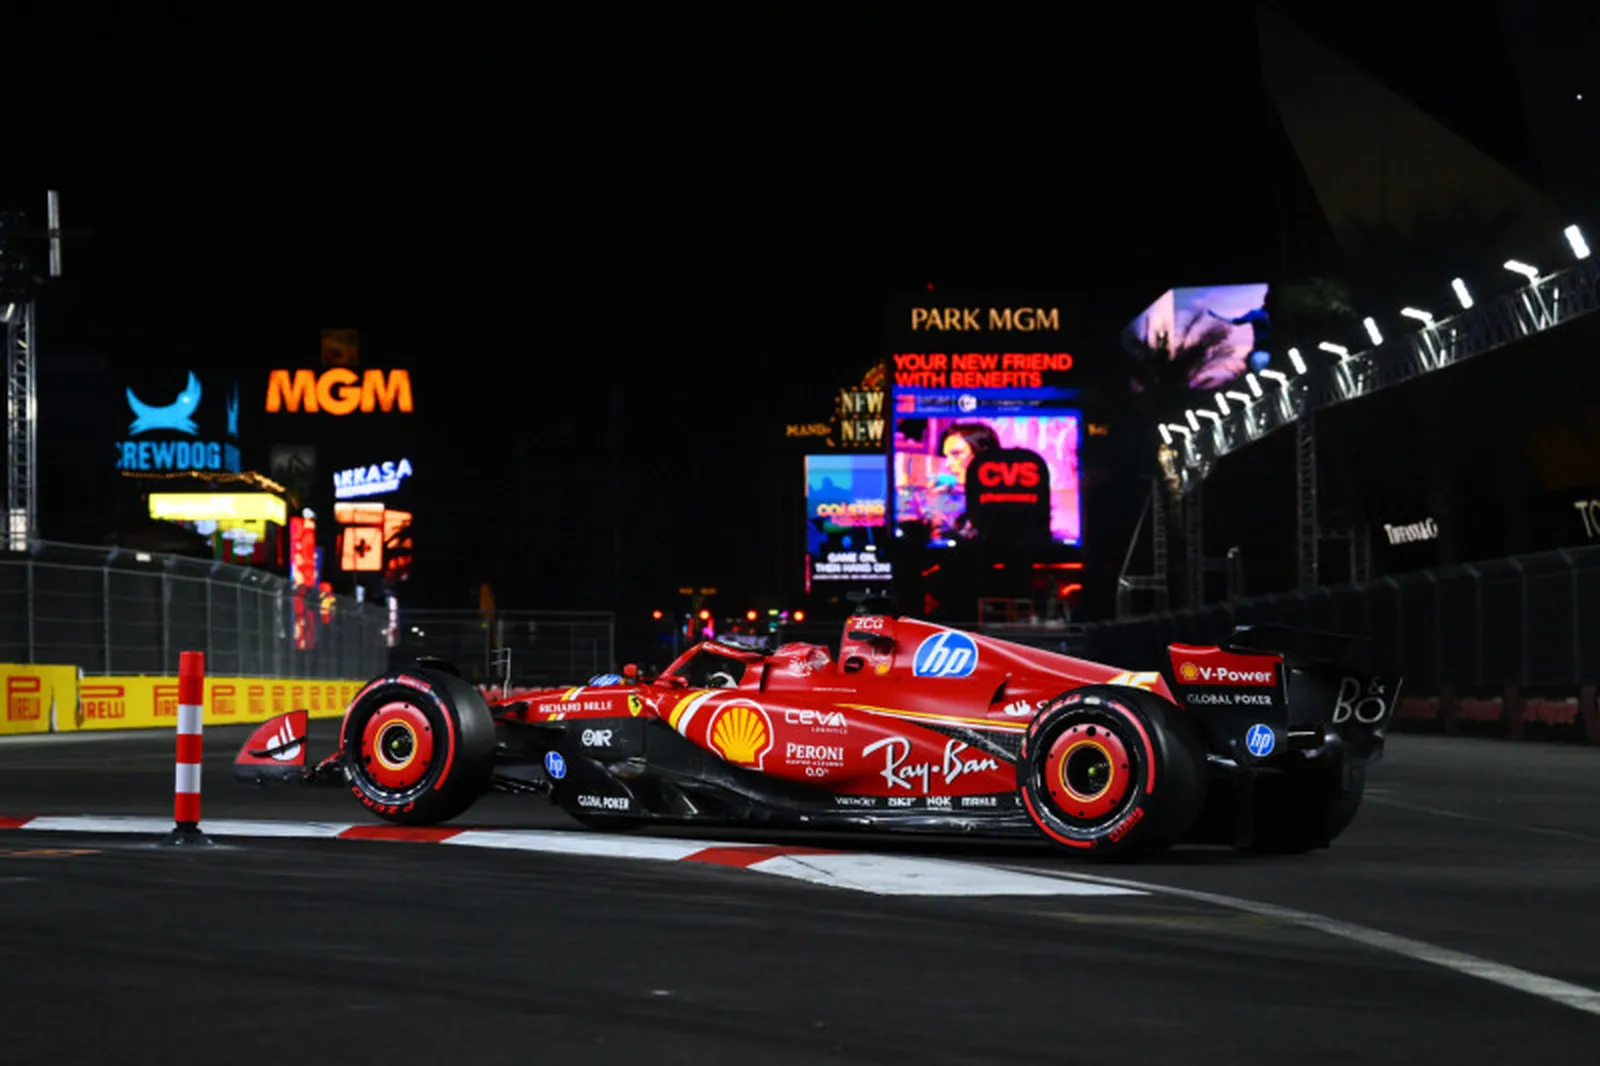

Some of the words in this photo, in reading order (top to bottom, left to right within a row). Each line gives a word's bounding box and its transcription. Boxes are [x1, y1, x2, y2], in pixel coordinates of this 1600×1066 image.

[911, 307, 980, 331] PARK
[988, 307, 1060, 331] MGM
[893, 354, 947, 371] YOUR
[951, 354, 997, 371] NEW
[1001, 354, 1073, 371] FRIEND
[894, 372, 945, 388] WITH
[950, 372, 1042, 389] BENEFITS
[265, 369, 413, 415] MGM
[977, 461, 1039, 487] CVS
[854, 617, 883, 629] ZCG
[919, 632, 972, 676] hp
[1199, 667, 1271, 682] V-Power
[538, 702, 582, 714] RICHARD
[583, 700, 613, 711] MILLE
[1187, 694, 1231, 704] GLOBAL
[1234, 694, 1271, 705] POKER
[1246, 724, 1275, 756] hp
[785, 742, 844, 761] PERONI
[546, 753, 564, 778] hp
[861, 737, 999, 793] Ray-Ban
[577, 795, 602, 807] GLOBAL
[603, 796, 630, 809] POKER
[962, 797, 997, 807] MAHLE
